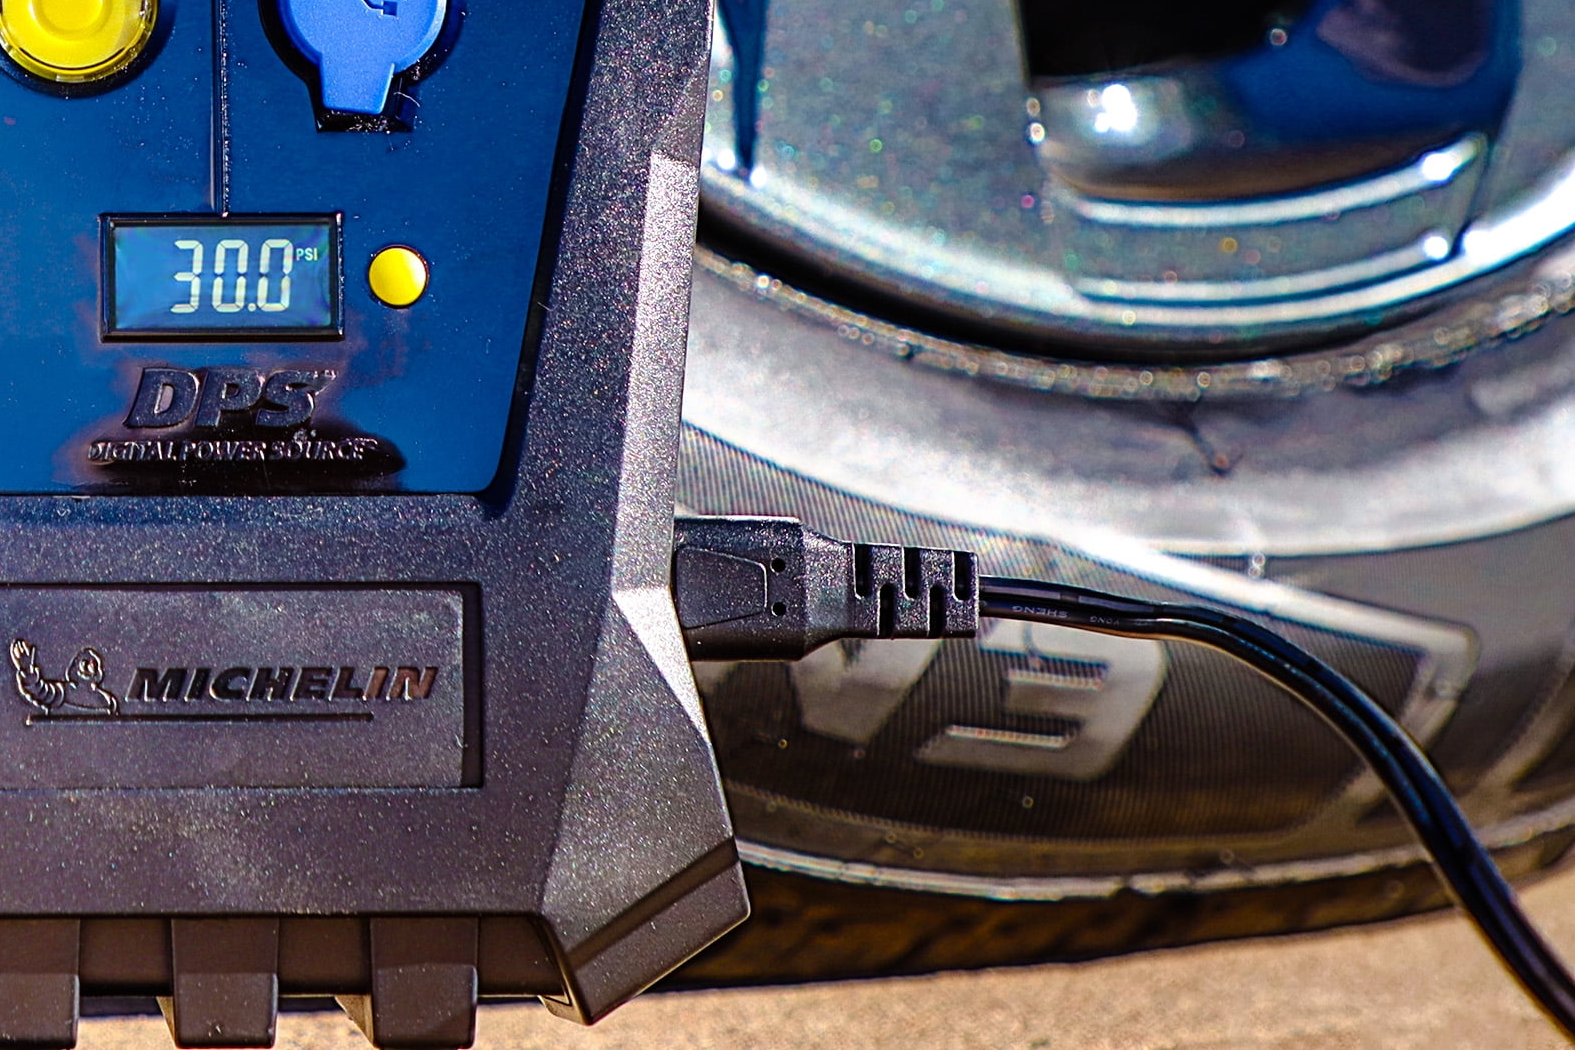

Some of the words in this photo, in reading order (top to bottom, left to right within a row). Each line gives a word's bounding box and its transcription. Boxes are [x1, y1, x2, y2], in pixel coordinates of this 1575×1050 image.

[170, 239, 294, 314] 30.0
[296, 247, 319, 262] PSI
[122, 365, 337, 429] DPS
[87, 439, 177, 462] DIGITAL
[179, 439, 267, 462] POWER
[271, 436, 378, 461] SOURCE
[1011, 605, 1068, 619] SHENG
[125, 666, 440, 702] MICHELIN
